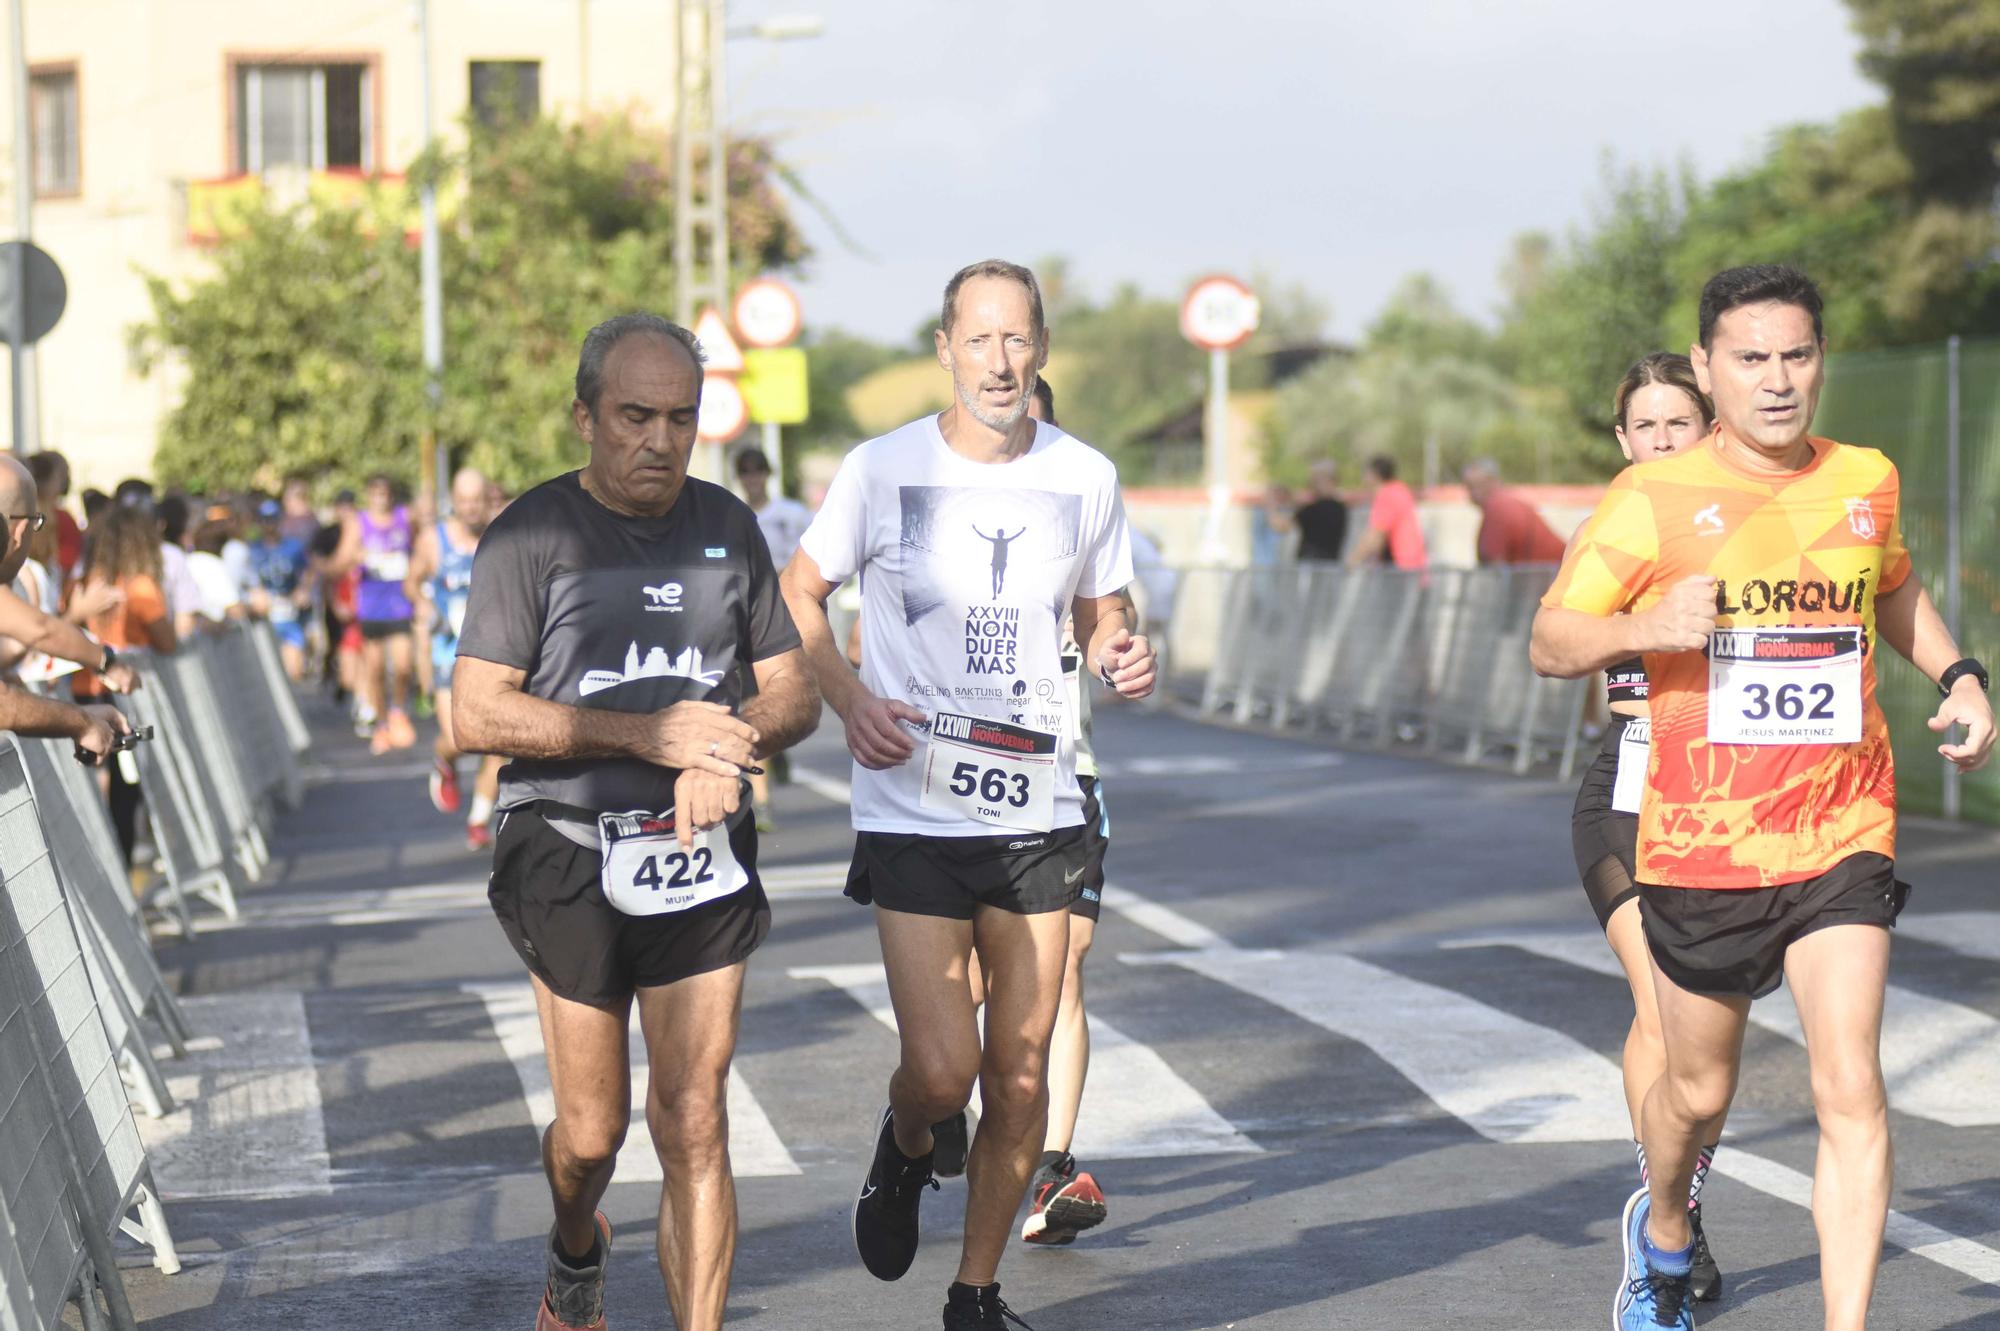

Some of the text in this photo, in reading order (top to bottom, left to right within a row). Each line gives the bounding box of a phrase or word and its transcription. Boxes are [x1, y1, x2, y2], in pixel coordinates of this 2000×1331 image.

[1717, 567, 1871, 615] LORQUÍ
[967, 606, 1019, 621] XXVIII
[966, 620, 1018, 638] NON
[966, 638, 1017, 656] DUER
[1715, 633, 1755, 657] XXVIII
[1755, 642, 1836, 658] NONDUERMAS
[966, 656, 1016, 675] MAS
[1742, 683, 1835, 720] 362
[935, 713, 972, 740] XXVIII
[1739, 728, 1834, 737] JESUS MARTINEZ
[949, 761, 1030, 808] 563
[977, 807, 1001, 818] TONI
[632, 847, 714, 891] 422
